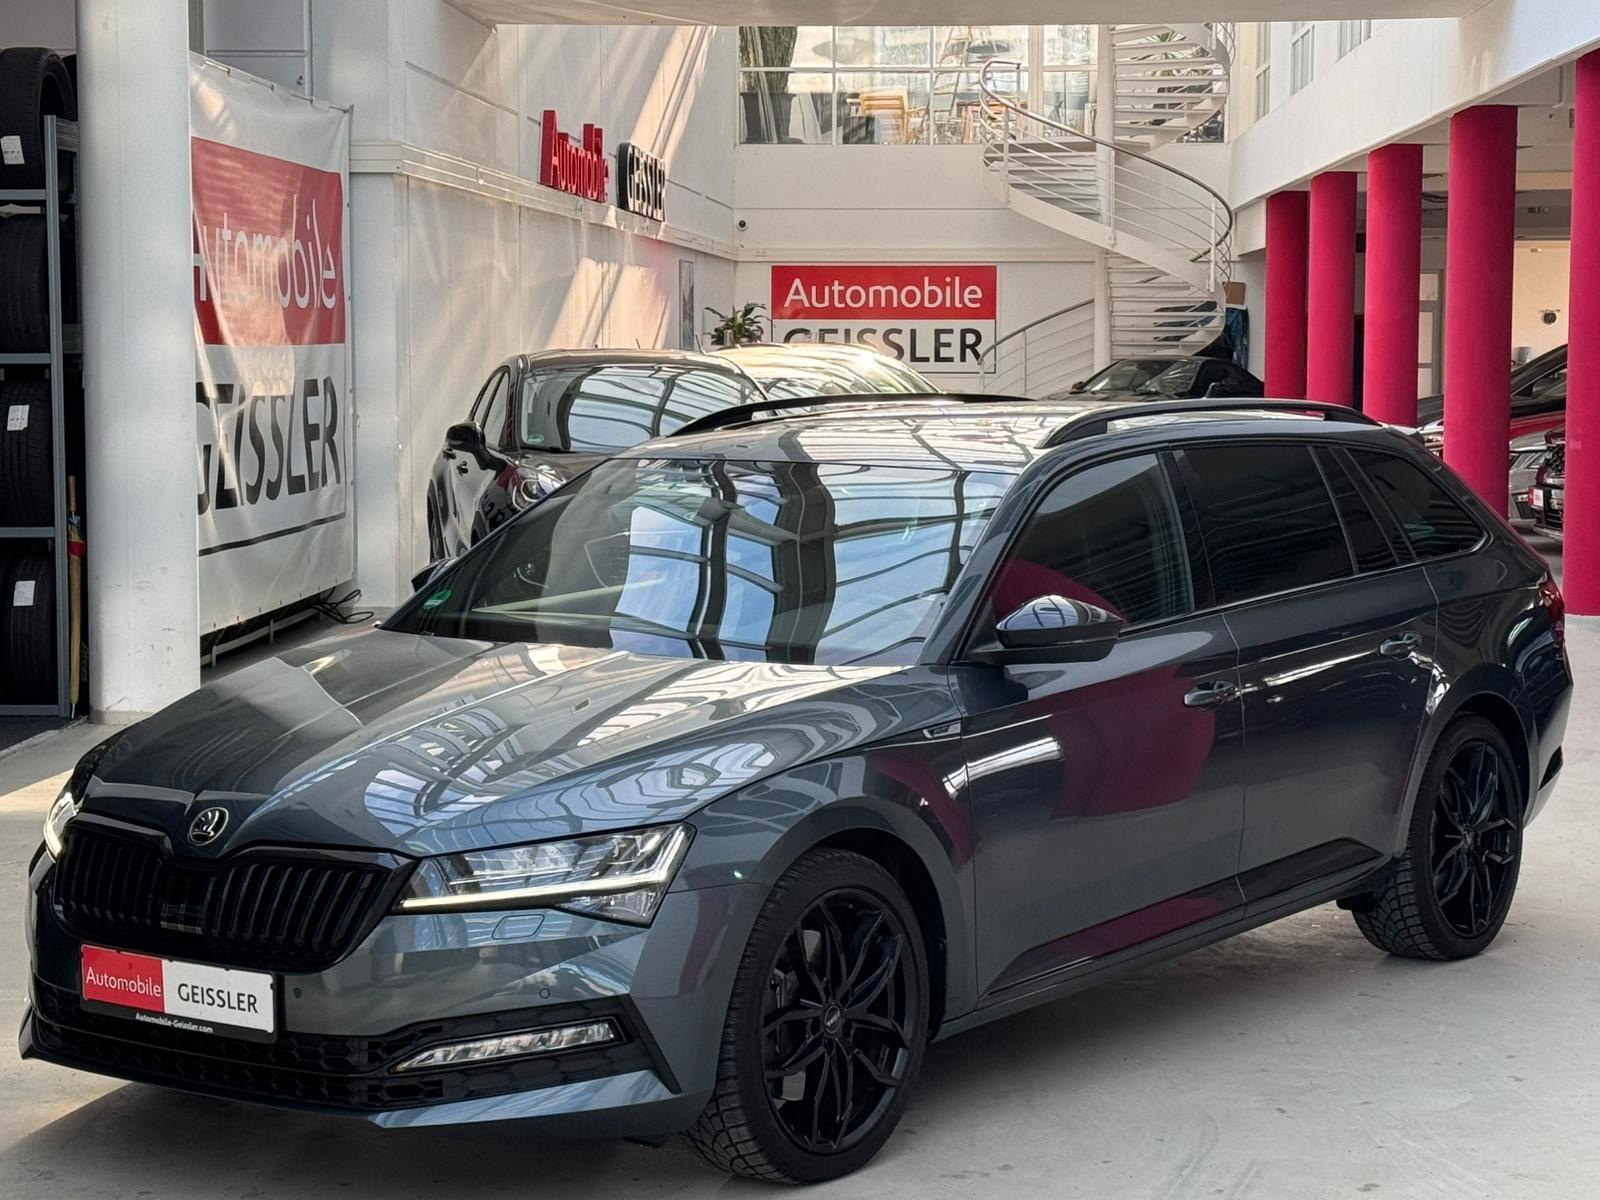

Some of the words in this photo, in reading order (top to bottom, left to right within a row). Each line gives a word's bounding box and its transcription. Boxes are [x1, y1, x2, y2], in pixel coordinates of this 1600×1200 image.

[783, 276, 982, 309] Automobile
[85, 966, 162, 998] Automobile
[177, 983, 259, 1014] GEISSLER
[135, 1012, 214, 1034] Automobile-Geissler.com
